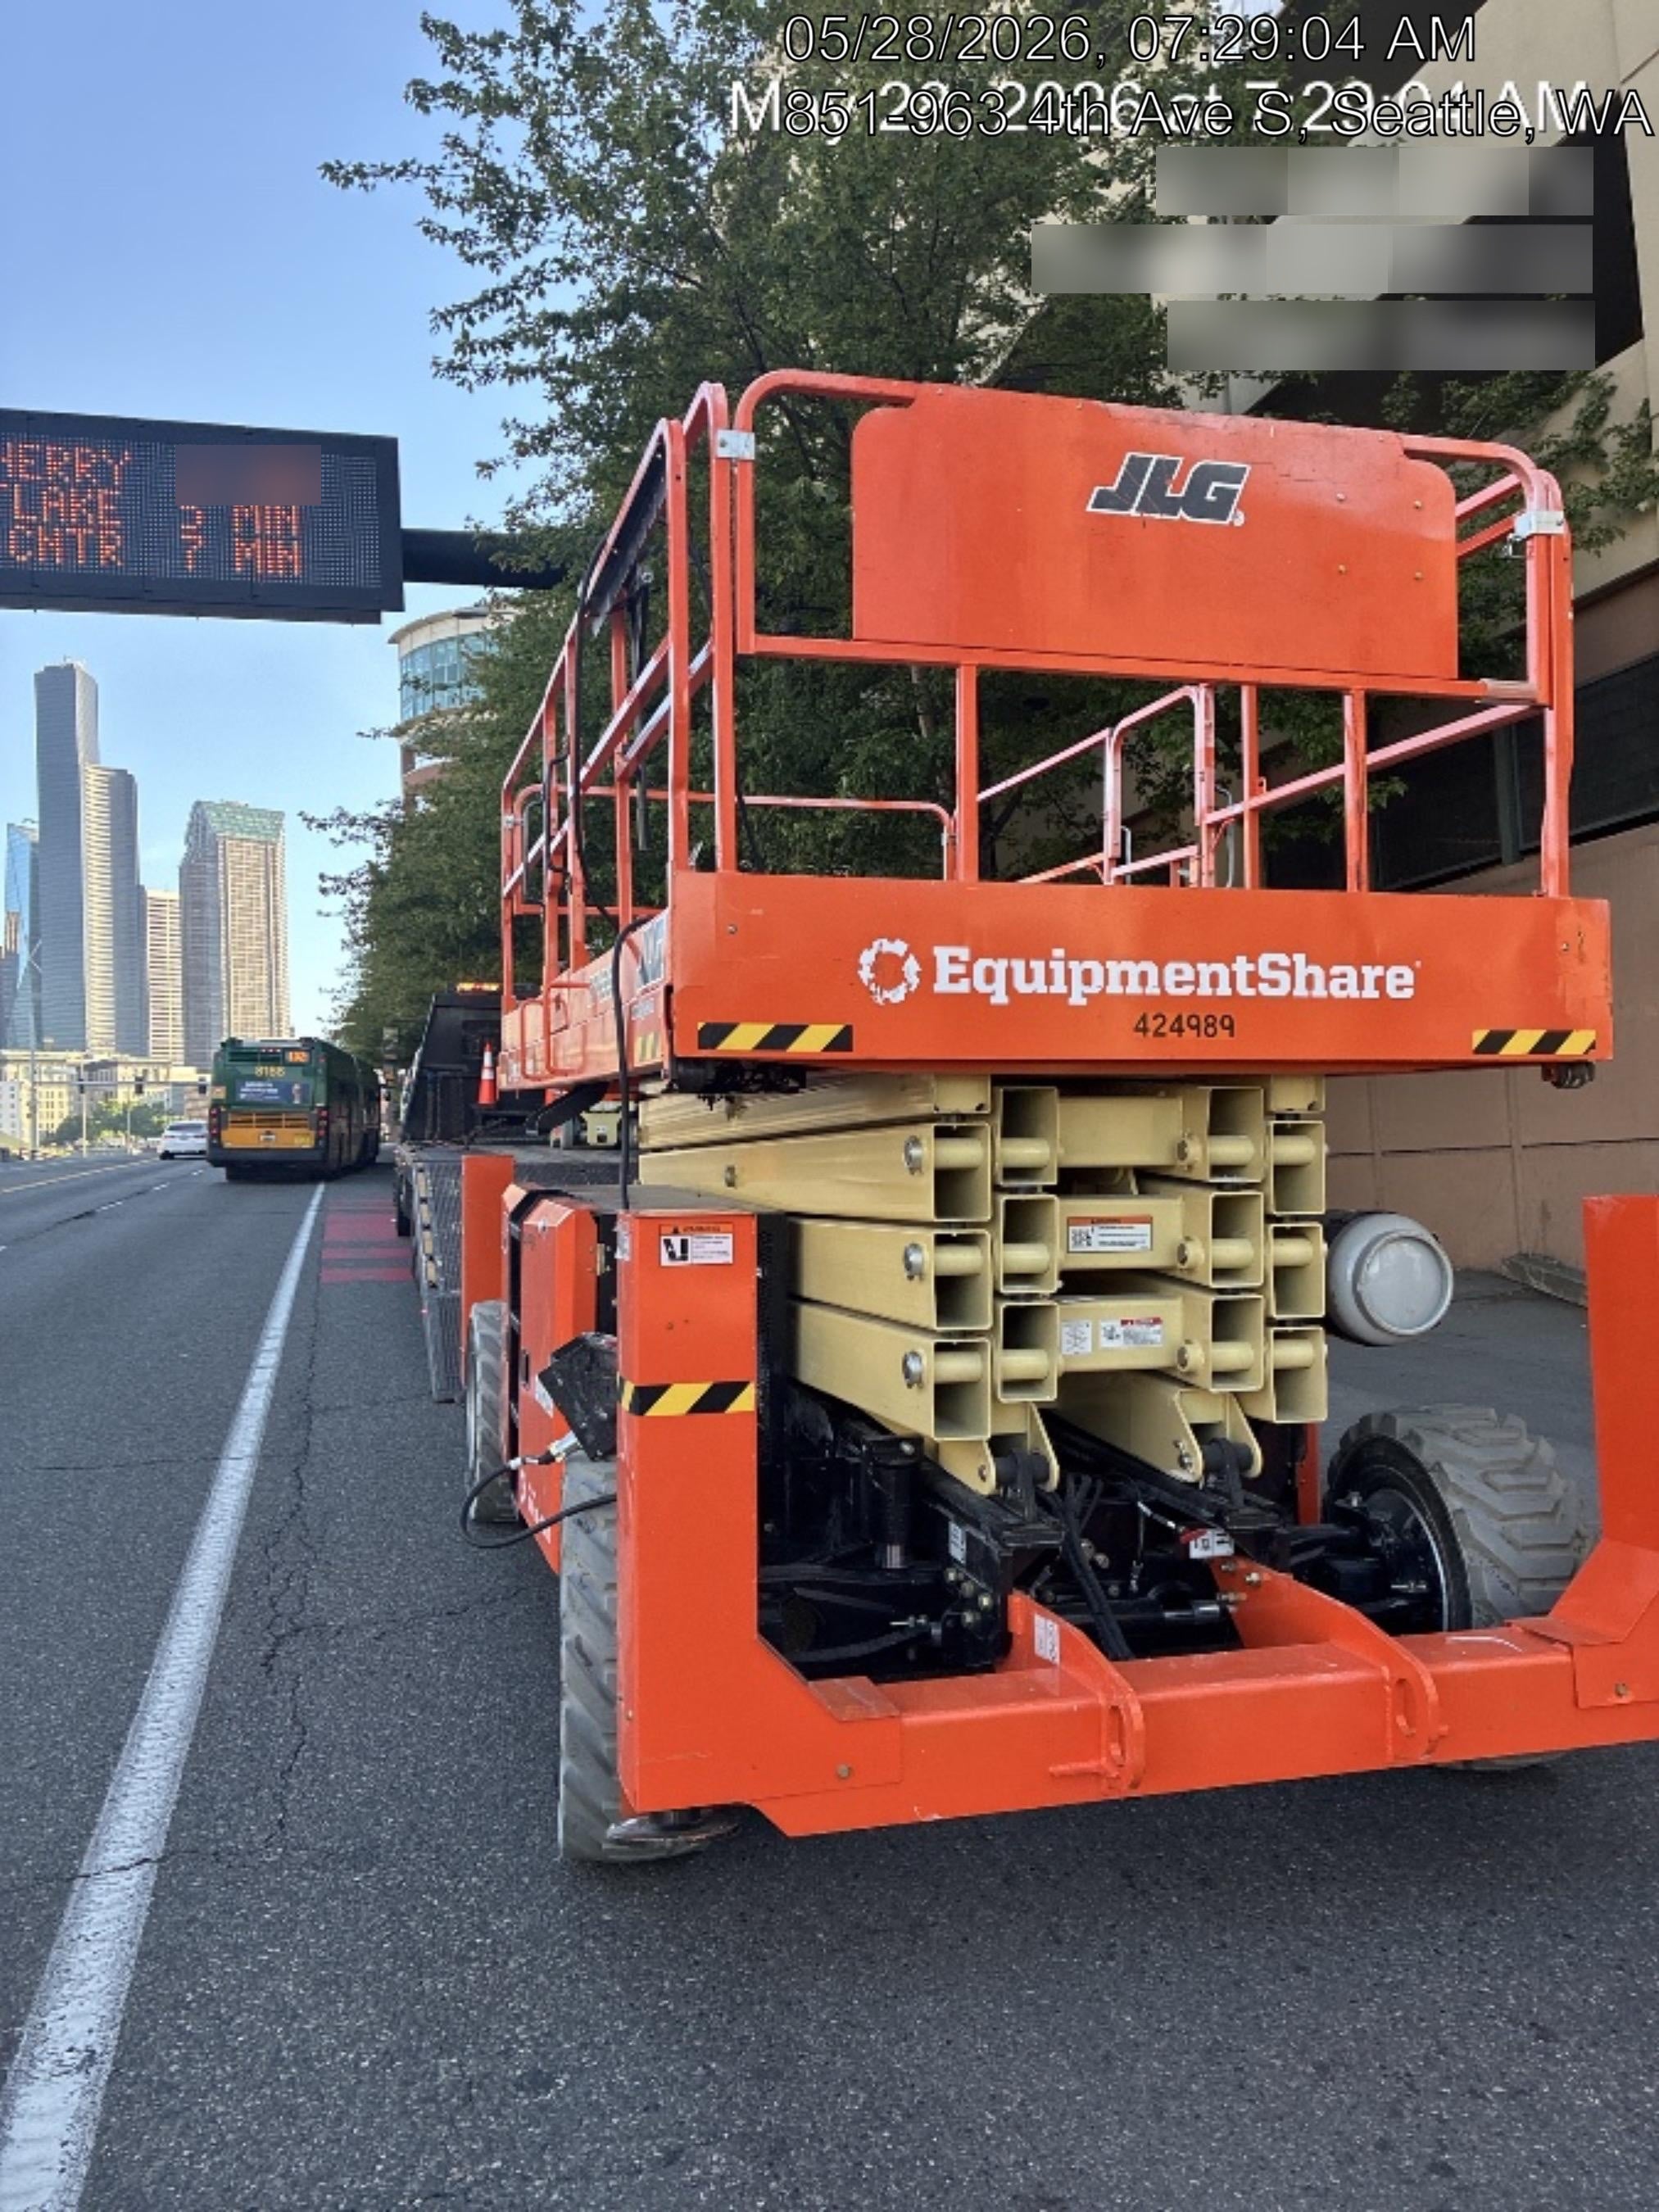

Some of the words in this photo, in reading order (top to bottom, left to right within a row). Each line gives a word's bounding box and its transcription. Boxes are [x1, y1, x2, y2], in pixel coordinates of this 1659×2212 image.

[0, 483, 120, 524] LAKE
[1086, 451, 1251, 525] JLG
[932, 945, 1416, 1005] EquipmentShare
[1134, 1012, 1235, 1039] 424989
